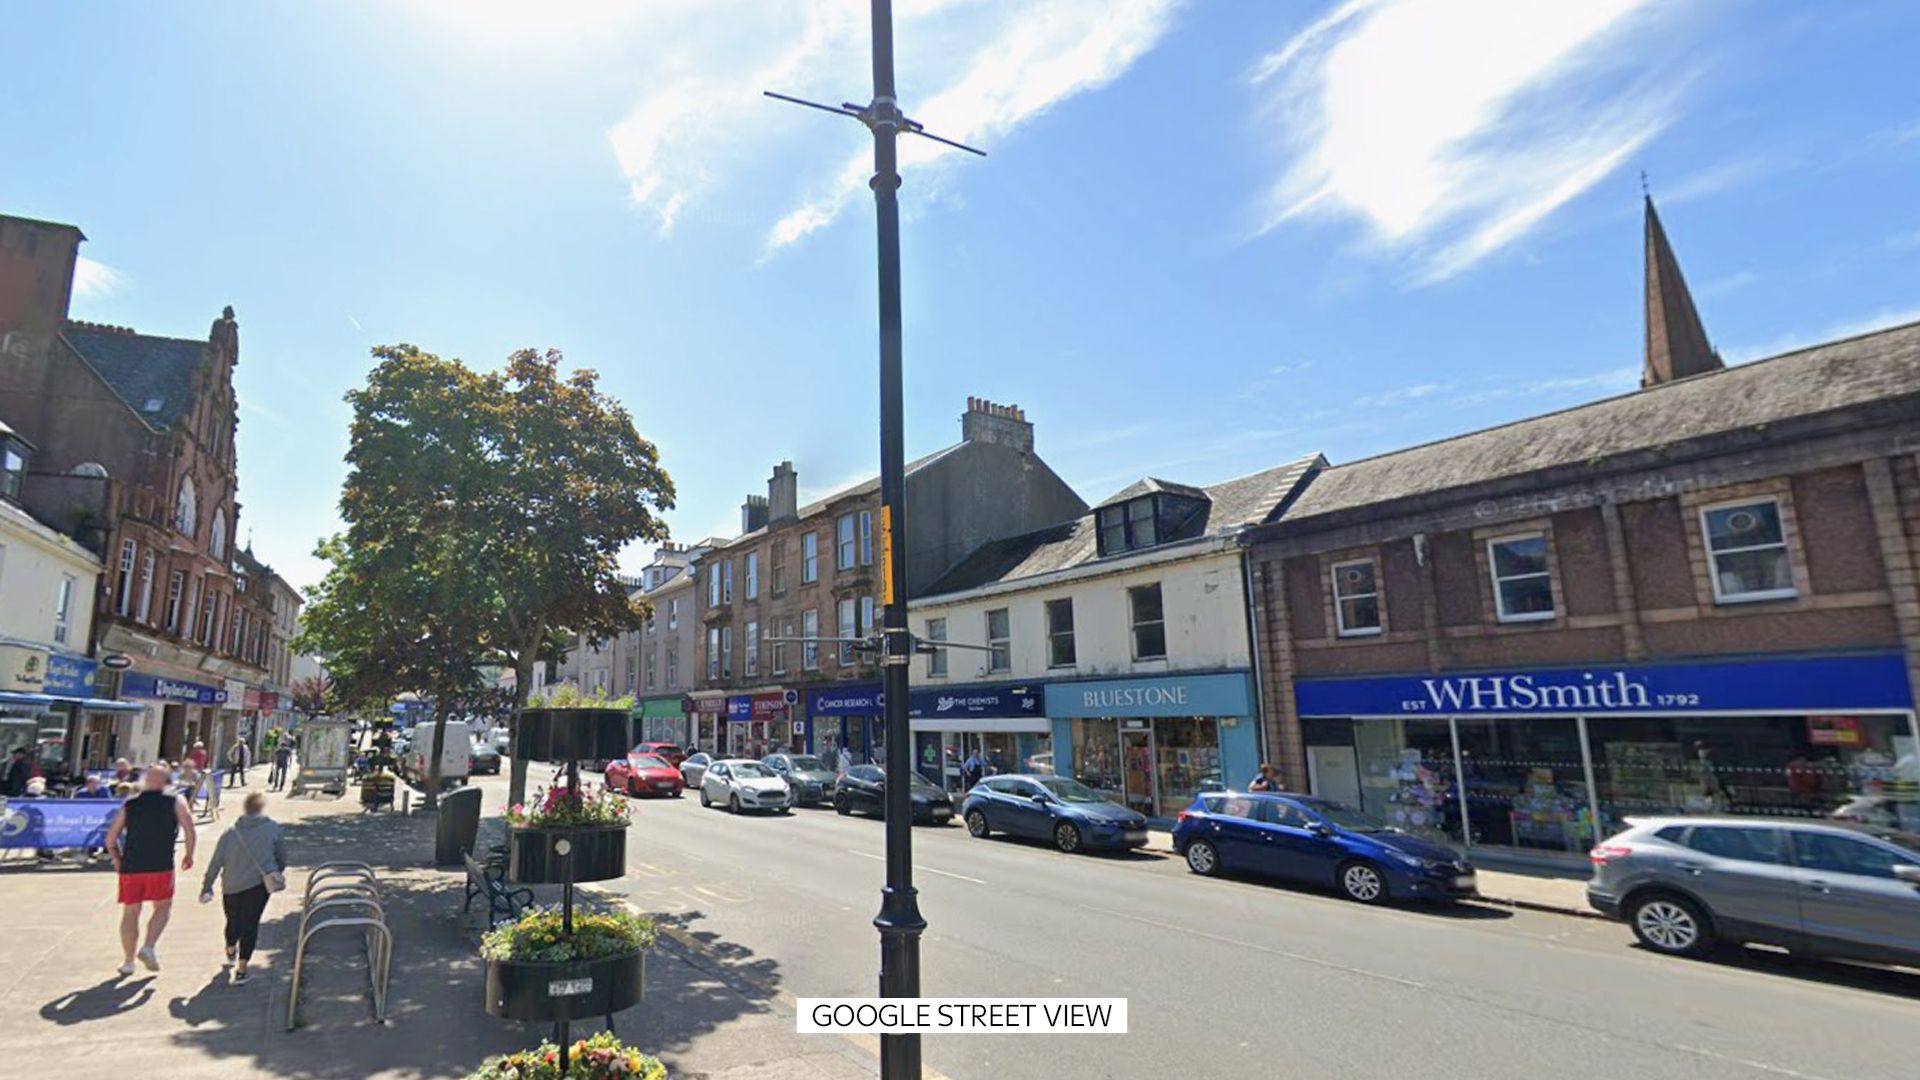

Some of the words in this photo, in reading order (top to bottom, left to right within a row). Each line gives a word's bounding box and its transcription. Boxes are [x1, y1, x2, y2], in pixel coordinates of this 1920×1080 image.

[1083, 686, 1187, 708] BLUESTONE
[1401, 700, 1427, 711] EST
[1422, 671, 1651, 710] WHSmith
[1656, 693, 1699, 706] 1792
[824, 699, 844, 708] CANCER
[967, 696, 1000, 706] CHEMISTS
